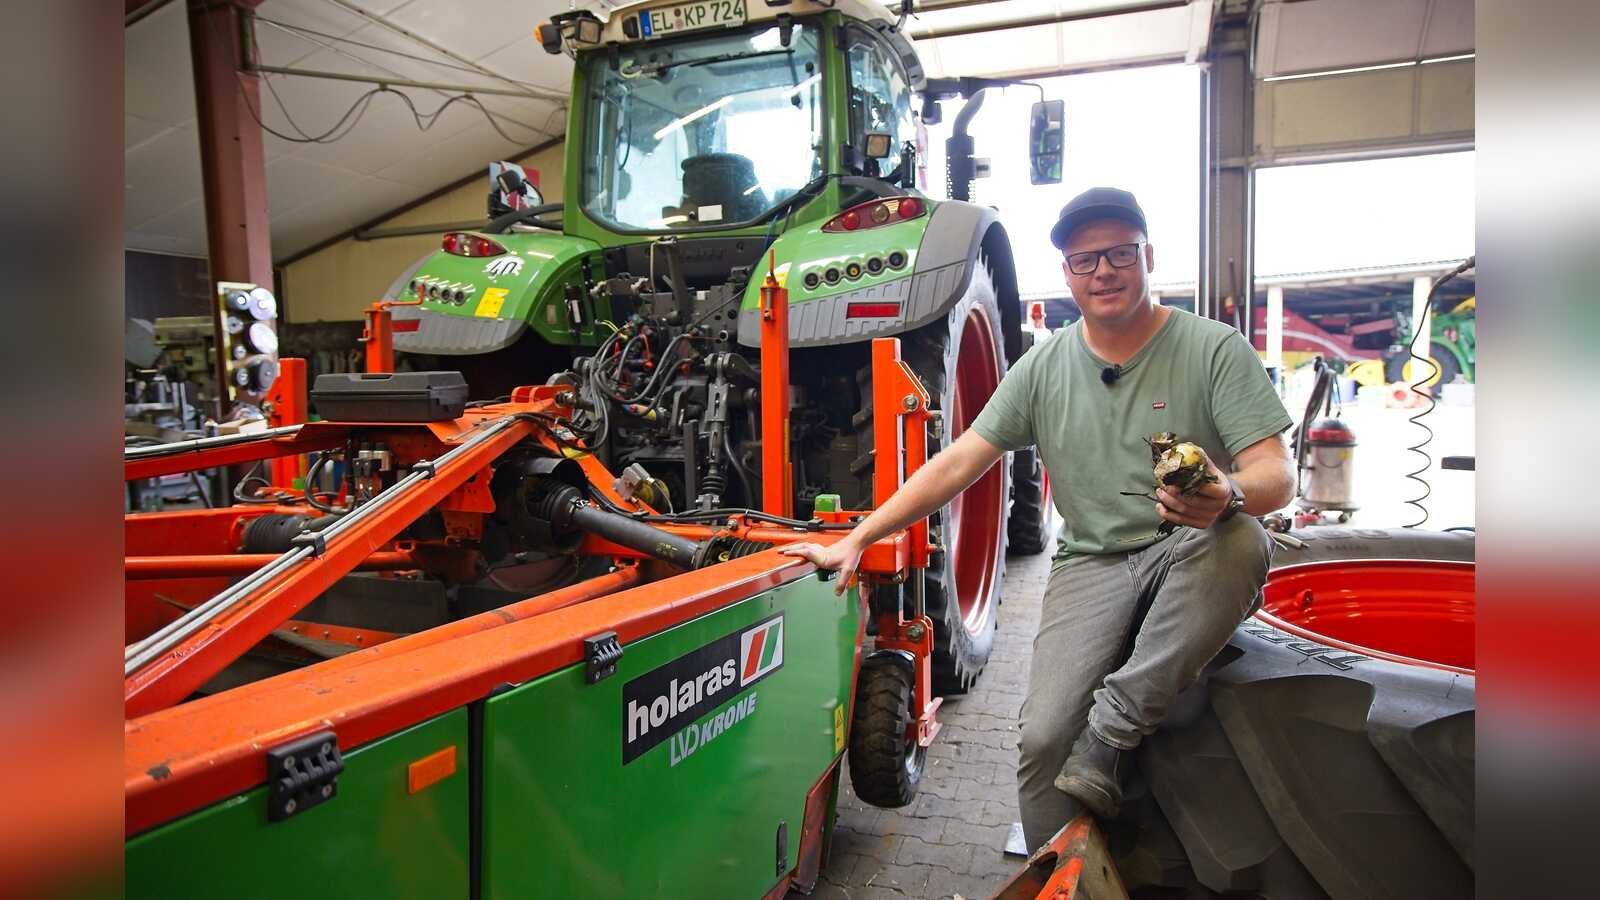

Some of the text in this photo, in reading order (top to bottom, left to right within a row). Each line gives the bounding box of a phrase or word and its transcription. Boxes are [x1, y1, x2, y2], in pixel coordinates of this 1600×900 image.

[651, 0, 744, 32] EL KP 724
[628, 658, 737, 743] holaras
[700, 691, 758, 746] KRONE
